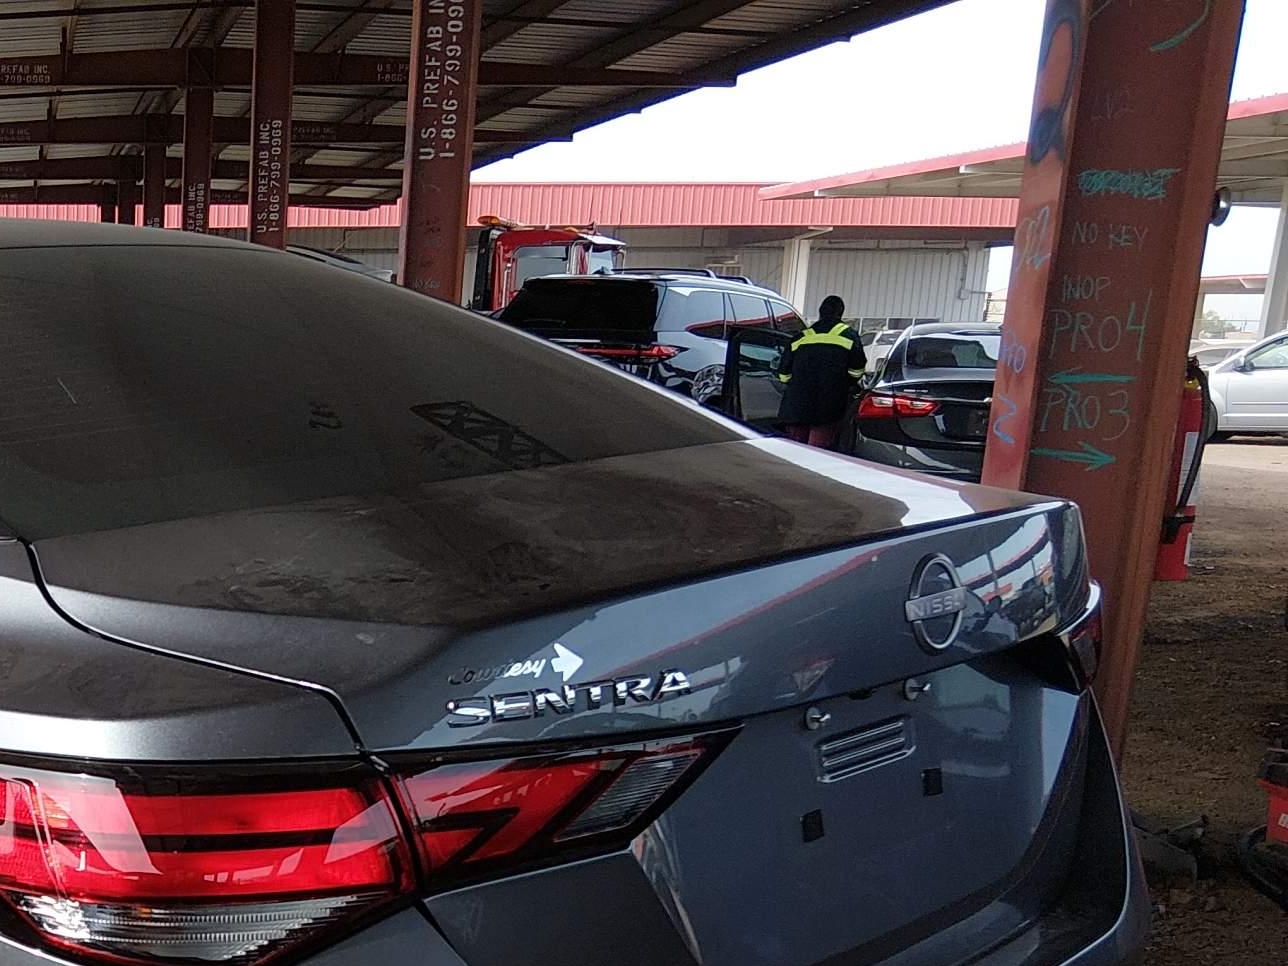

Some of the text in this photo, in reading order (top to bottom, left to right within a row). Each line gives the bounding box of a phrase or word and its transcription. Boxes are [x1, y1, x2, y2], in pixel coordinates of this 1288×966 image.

[423, 26, 443, 108] PREFAB
[439, 0, 465, 158] 1-866-799-09
[419, 121, 438, 160] U.S.
[257, 119, 271, 233] U.S. PREFAB INC.
[269, 120, 283, 232] 1-866-799-0969
[1072, 221, 1149, 249] NO KEY
[1062, 275, 1112, 303] INOP
[446, 669, 692, 729] SENTRA
[447, 657, 546, 686] Courtesy
